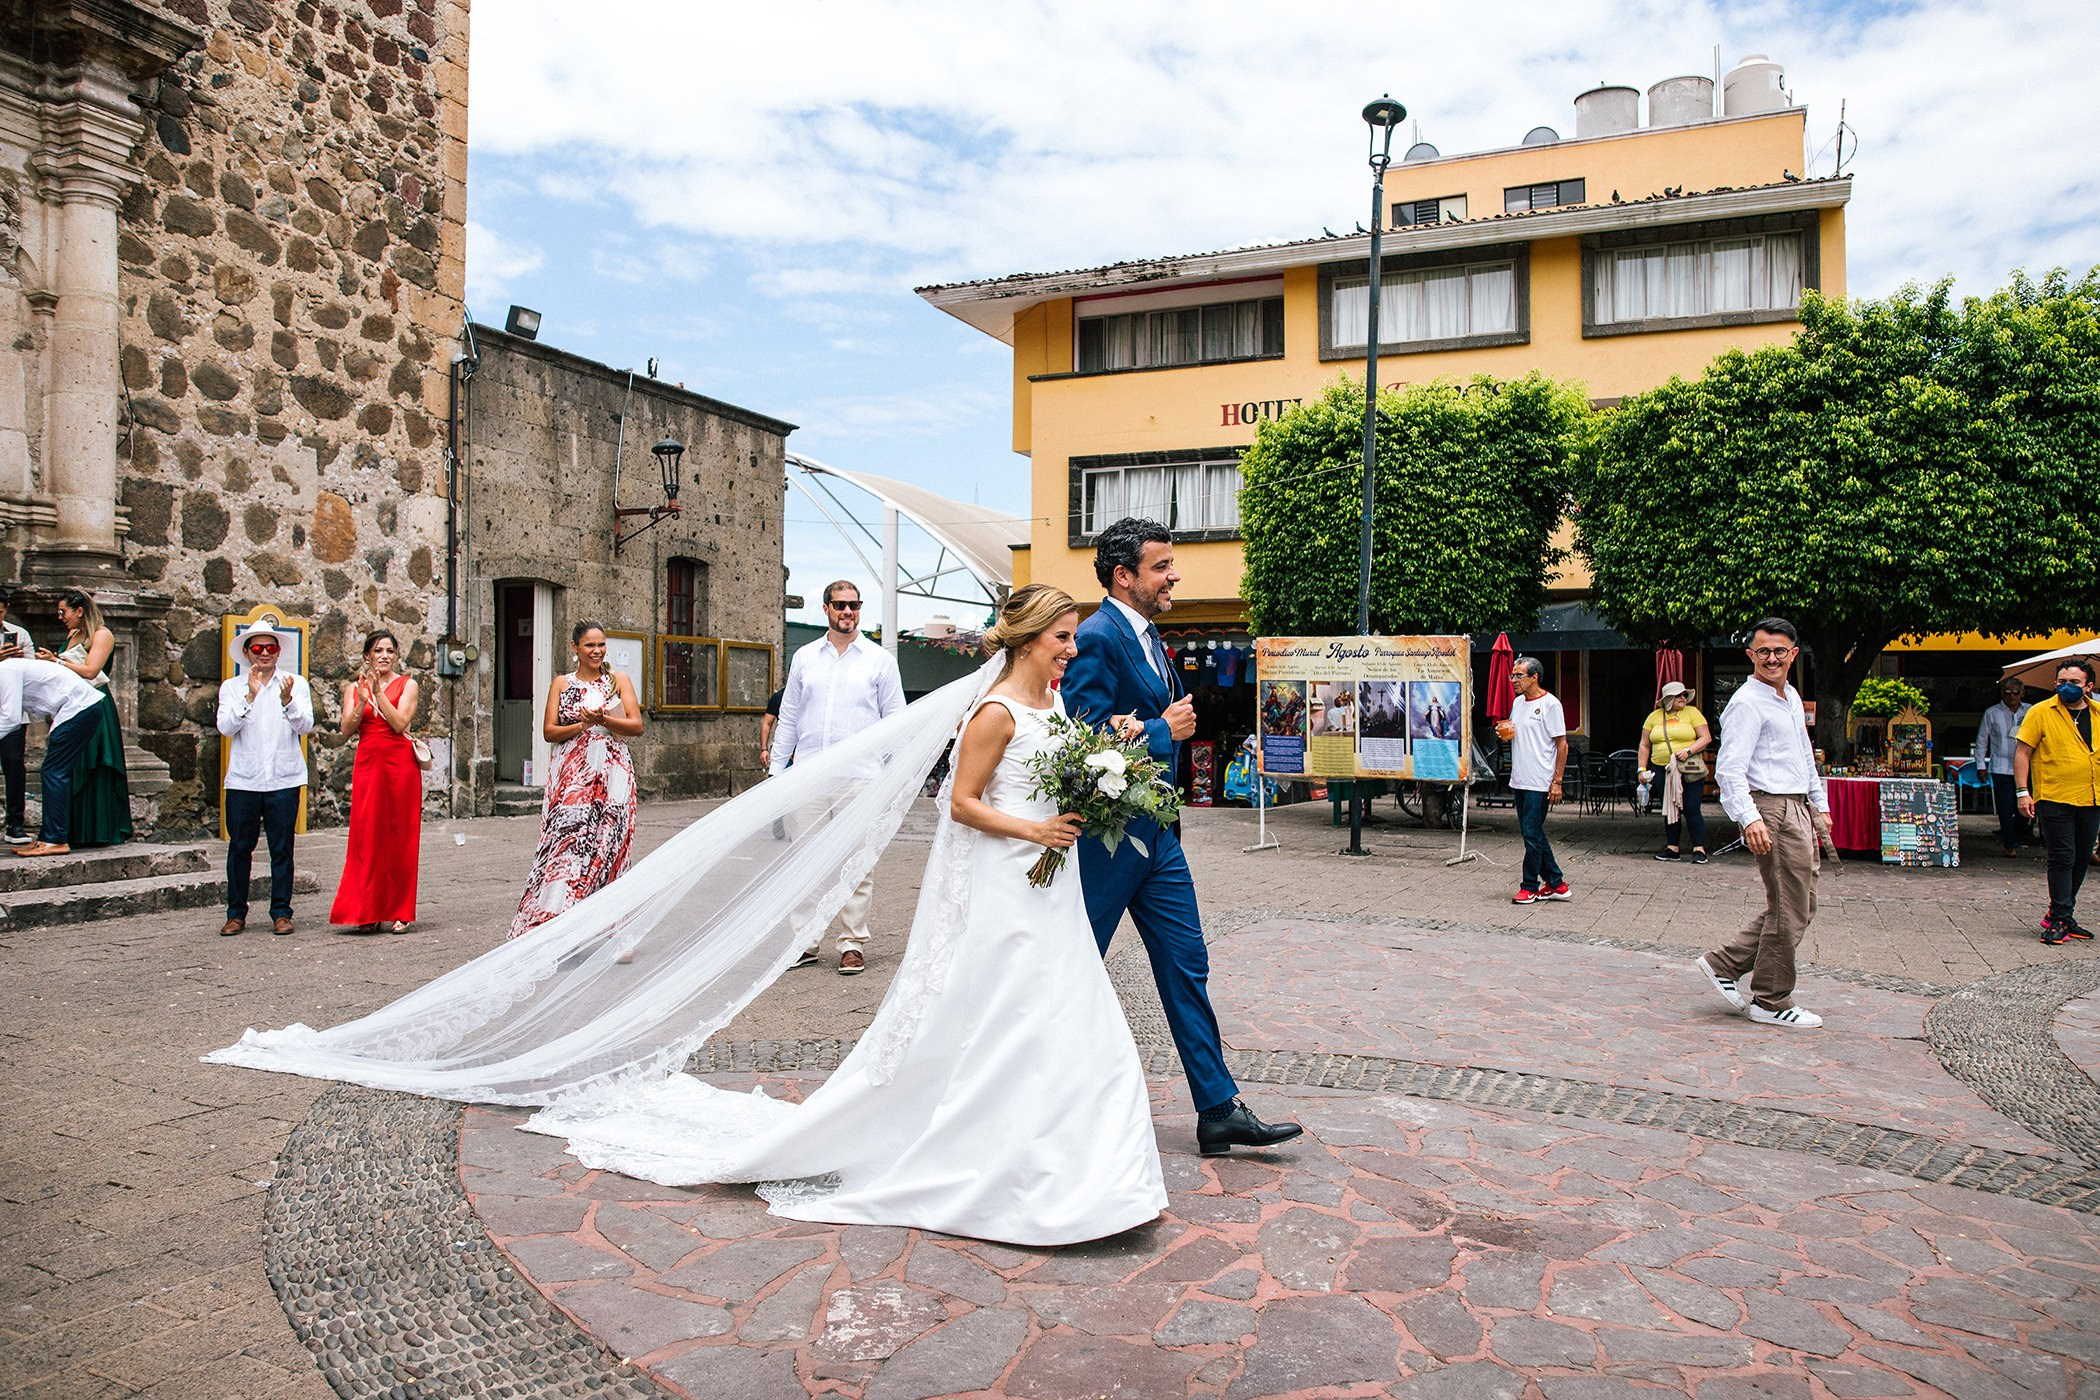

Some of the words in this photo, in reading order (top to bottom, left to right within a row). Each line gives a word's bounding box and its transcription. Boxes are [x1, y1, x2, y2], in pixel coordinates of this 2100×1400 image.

[1294, 647, 1322, 657] Mural
[1326, 641, 1370, 663] Agosto
[1374, 646, 1405, 659] Parroquia
[1405, 647, 1432, 659] Santiago
